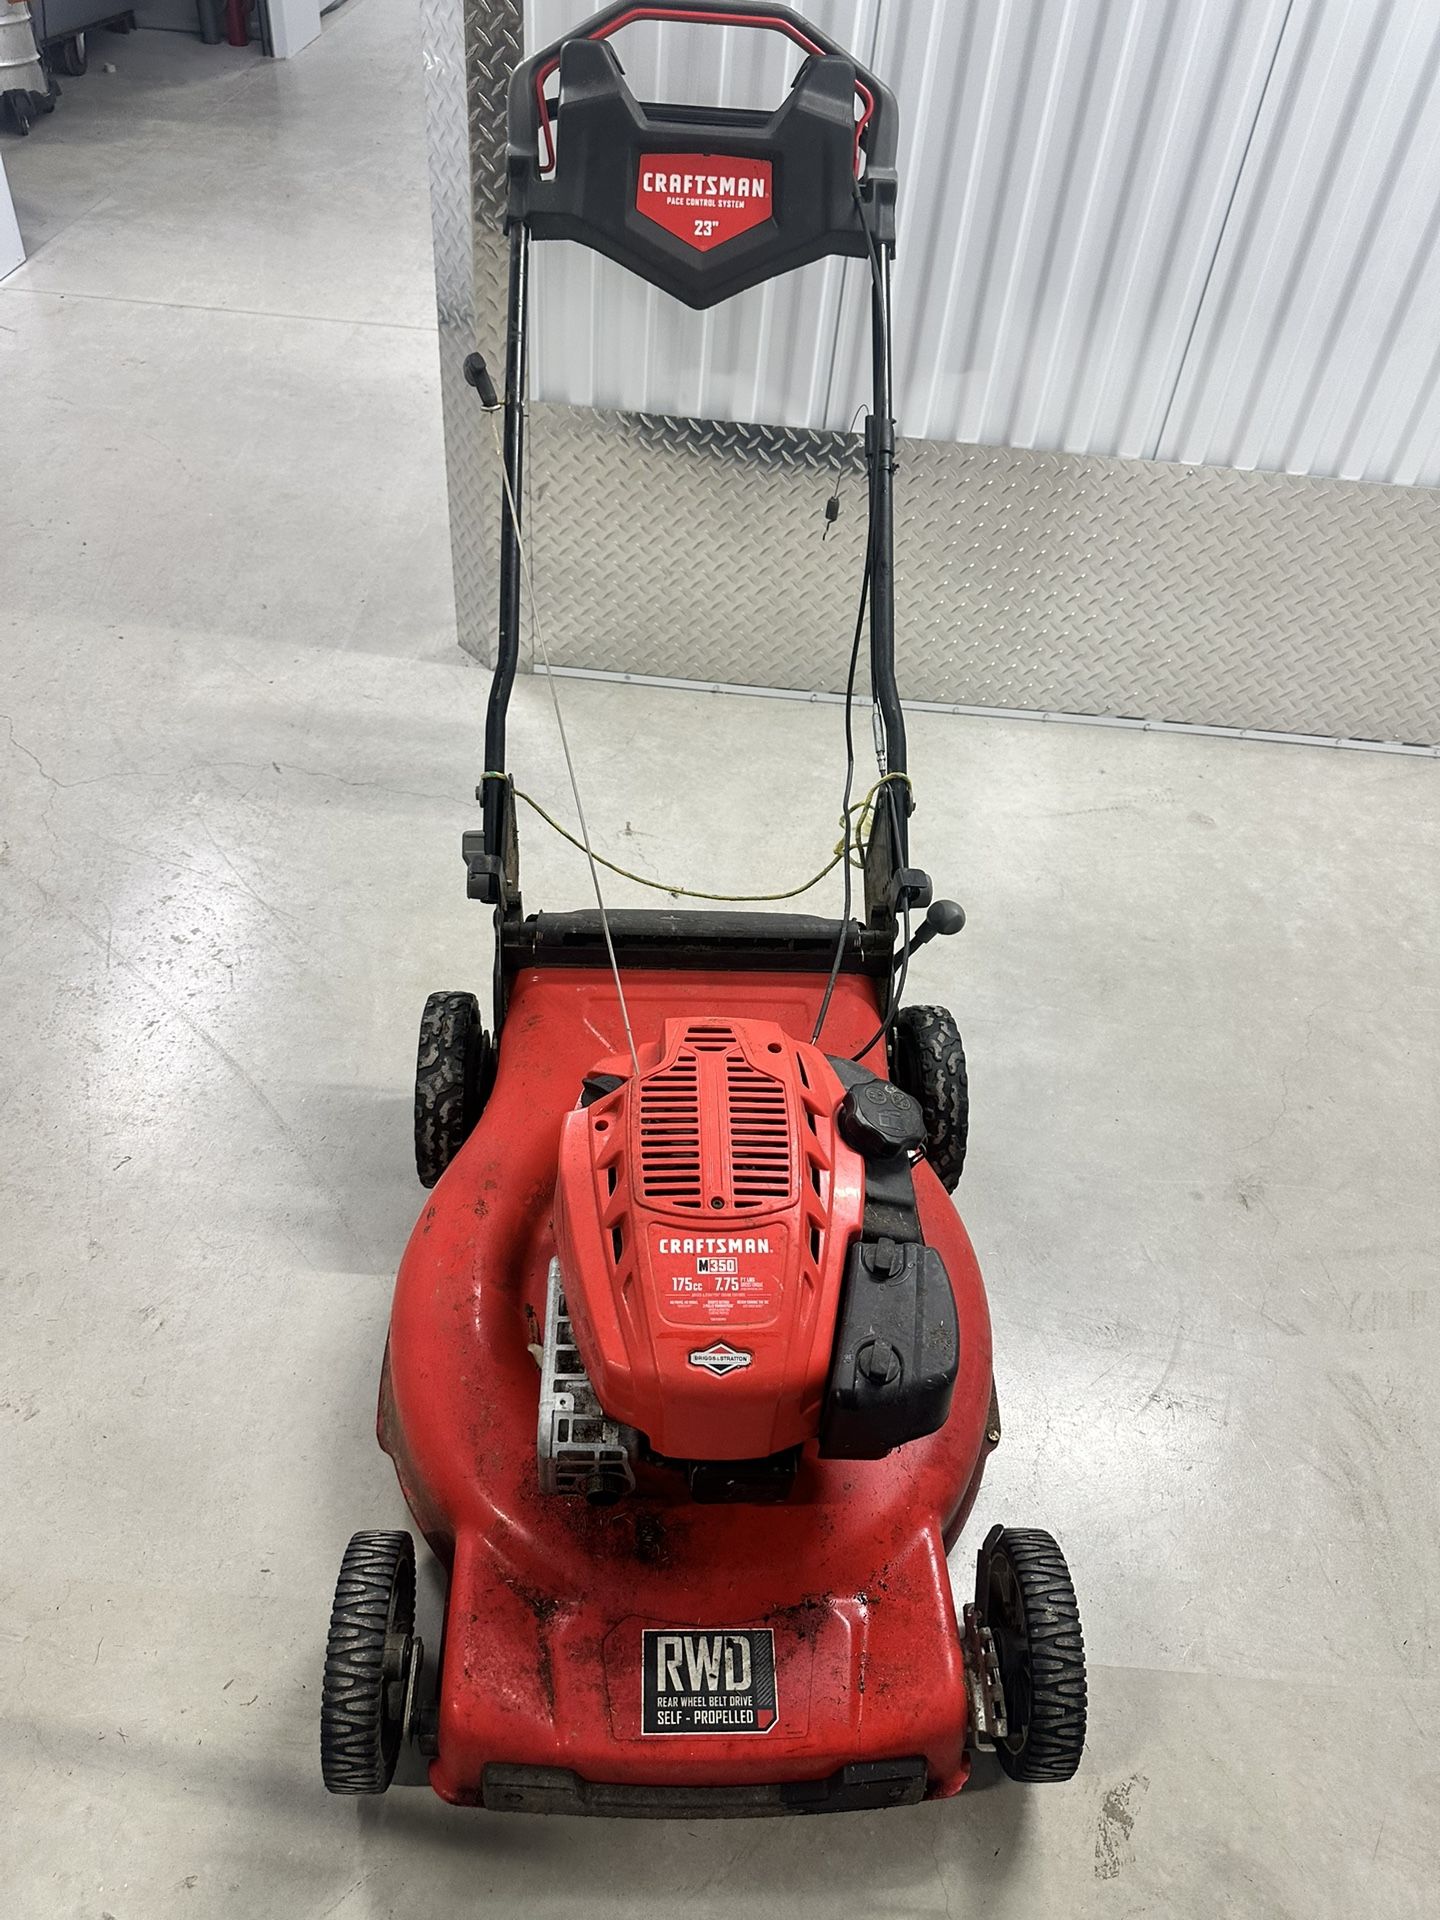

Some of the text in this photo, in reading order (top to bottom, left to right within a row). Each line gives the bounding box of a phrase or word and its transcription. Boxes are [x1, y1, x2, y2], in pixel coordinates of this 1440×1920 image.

[642, 172, 765, 198] CRAFTSMAN
[666, 196, 745, 209] PACE CONTROL SYSTEM
[694, 219, 720, 236] 23"
[659, 1238, 769, 1254] CRAFTSMAN
[698, 1259, 735, 1272] M350
[672, 1277, 703, 1291] 175cc
[715, 1277, 739, 1291] 7.75
[657, 1635, 752, 1692] RWD
[657, 1695, 753, 1708] REAR WHEEL BELT DRIVE
[657, 1710, 683, 1725] SELF
[694, 1709, 754, 1724] PROPELLED
